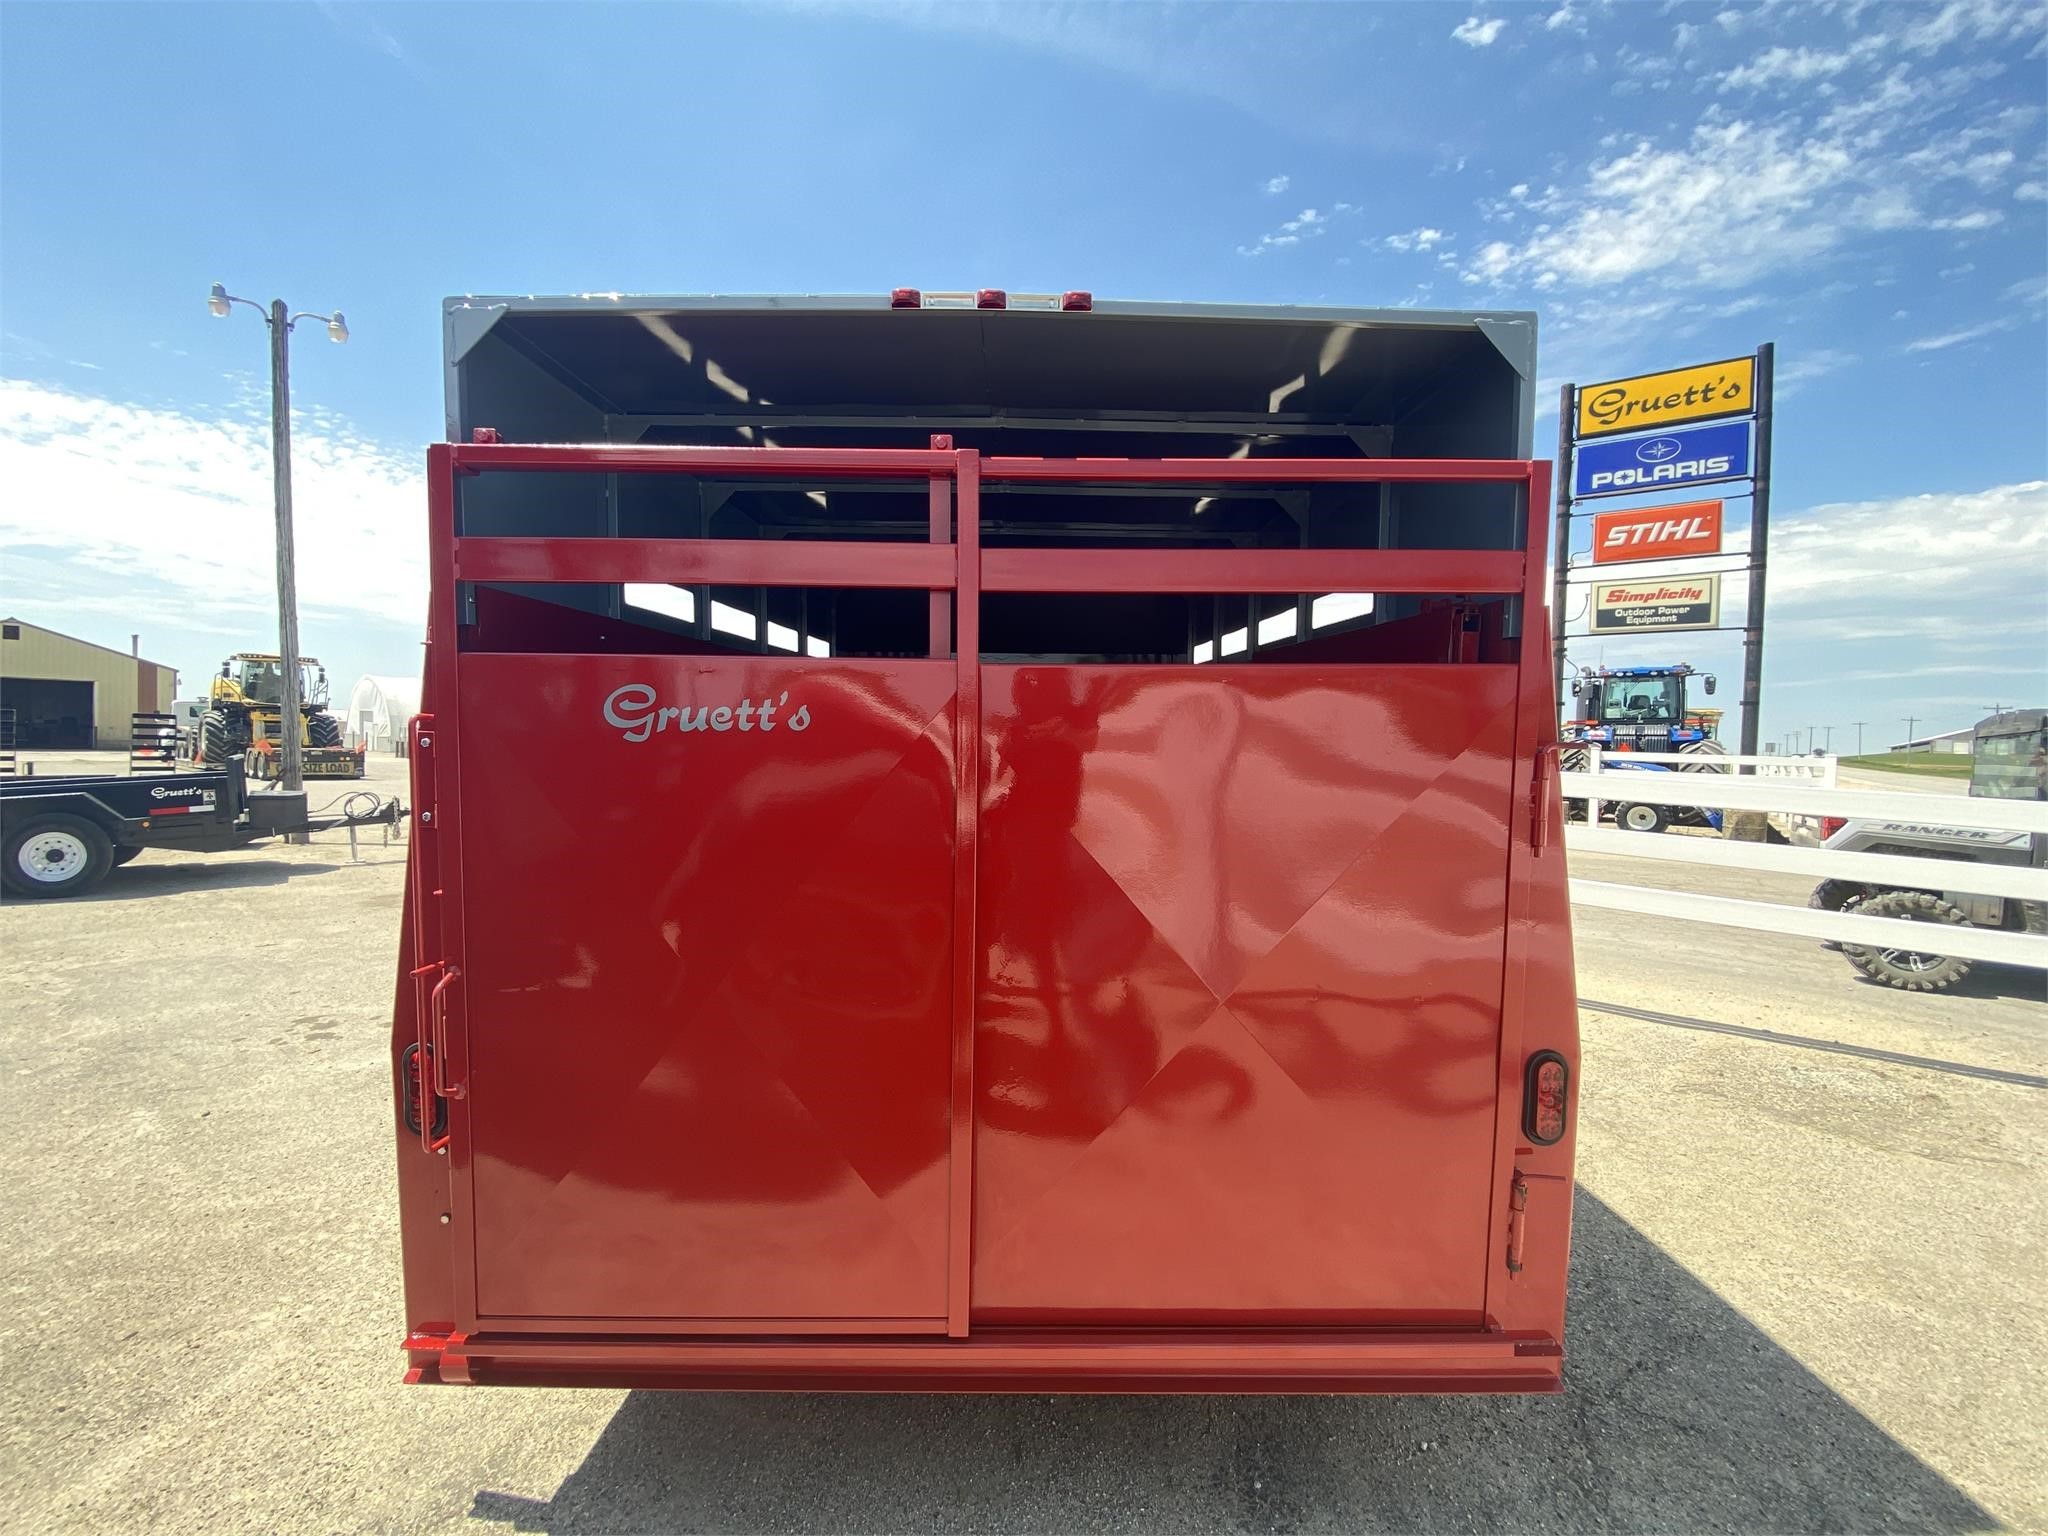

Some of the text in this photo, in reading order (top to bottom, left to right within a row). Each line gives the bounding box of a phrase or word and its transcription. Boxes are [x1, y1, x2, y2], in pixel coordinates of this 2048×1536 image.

[1588, 375, 1741, 425] Gruett's
[1591, 456, 1730, 489] POLARIS
[1603, 518, 1712, 548] STIHL
[1605, 587, 1703, 604] Simplicity
[1615, 606, 1690, 617] Outdoor Power
[1626, 615, 1678, 625] Equipment
[603, 683, 812, 743] Gruett's
[325, 763, 350, 773] LOAD
[151, 786, 202, 799] Gruett's
[1883, 823, 1990, 839] RANGER
